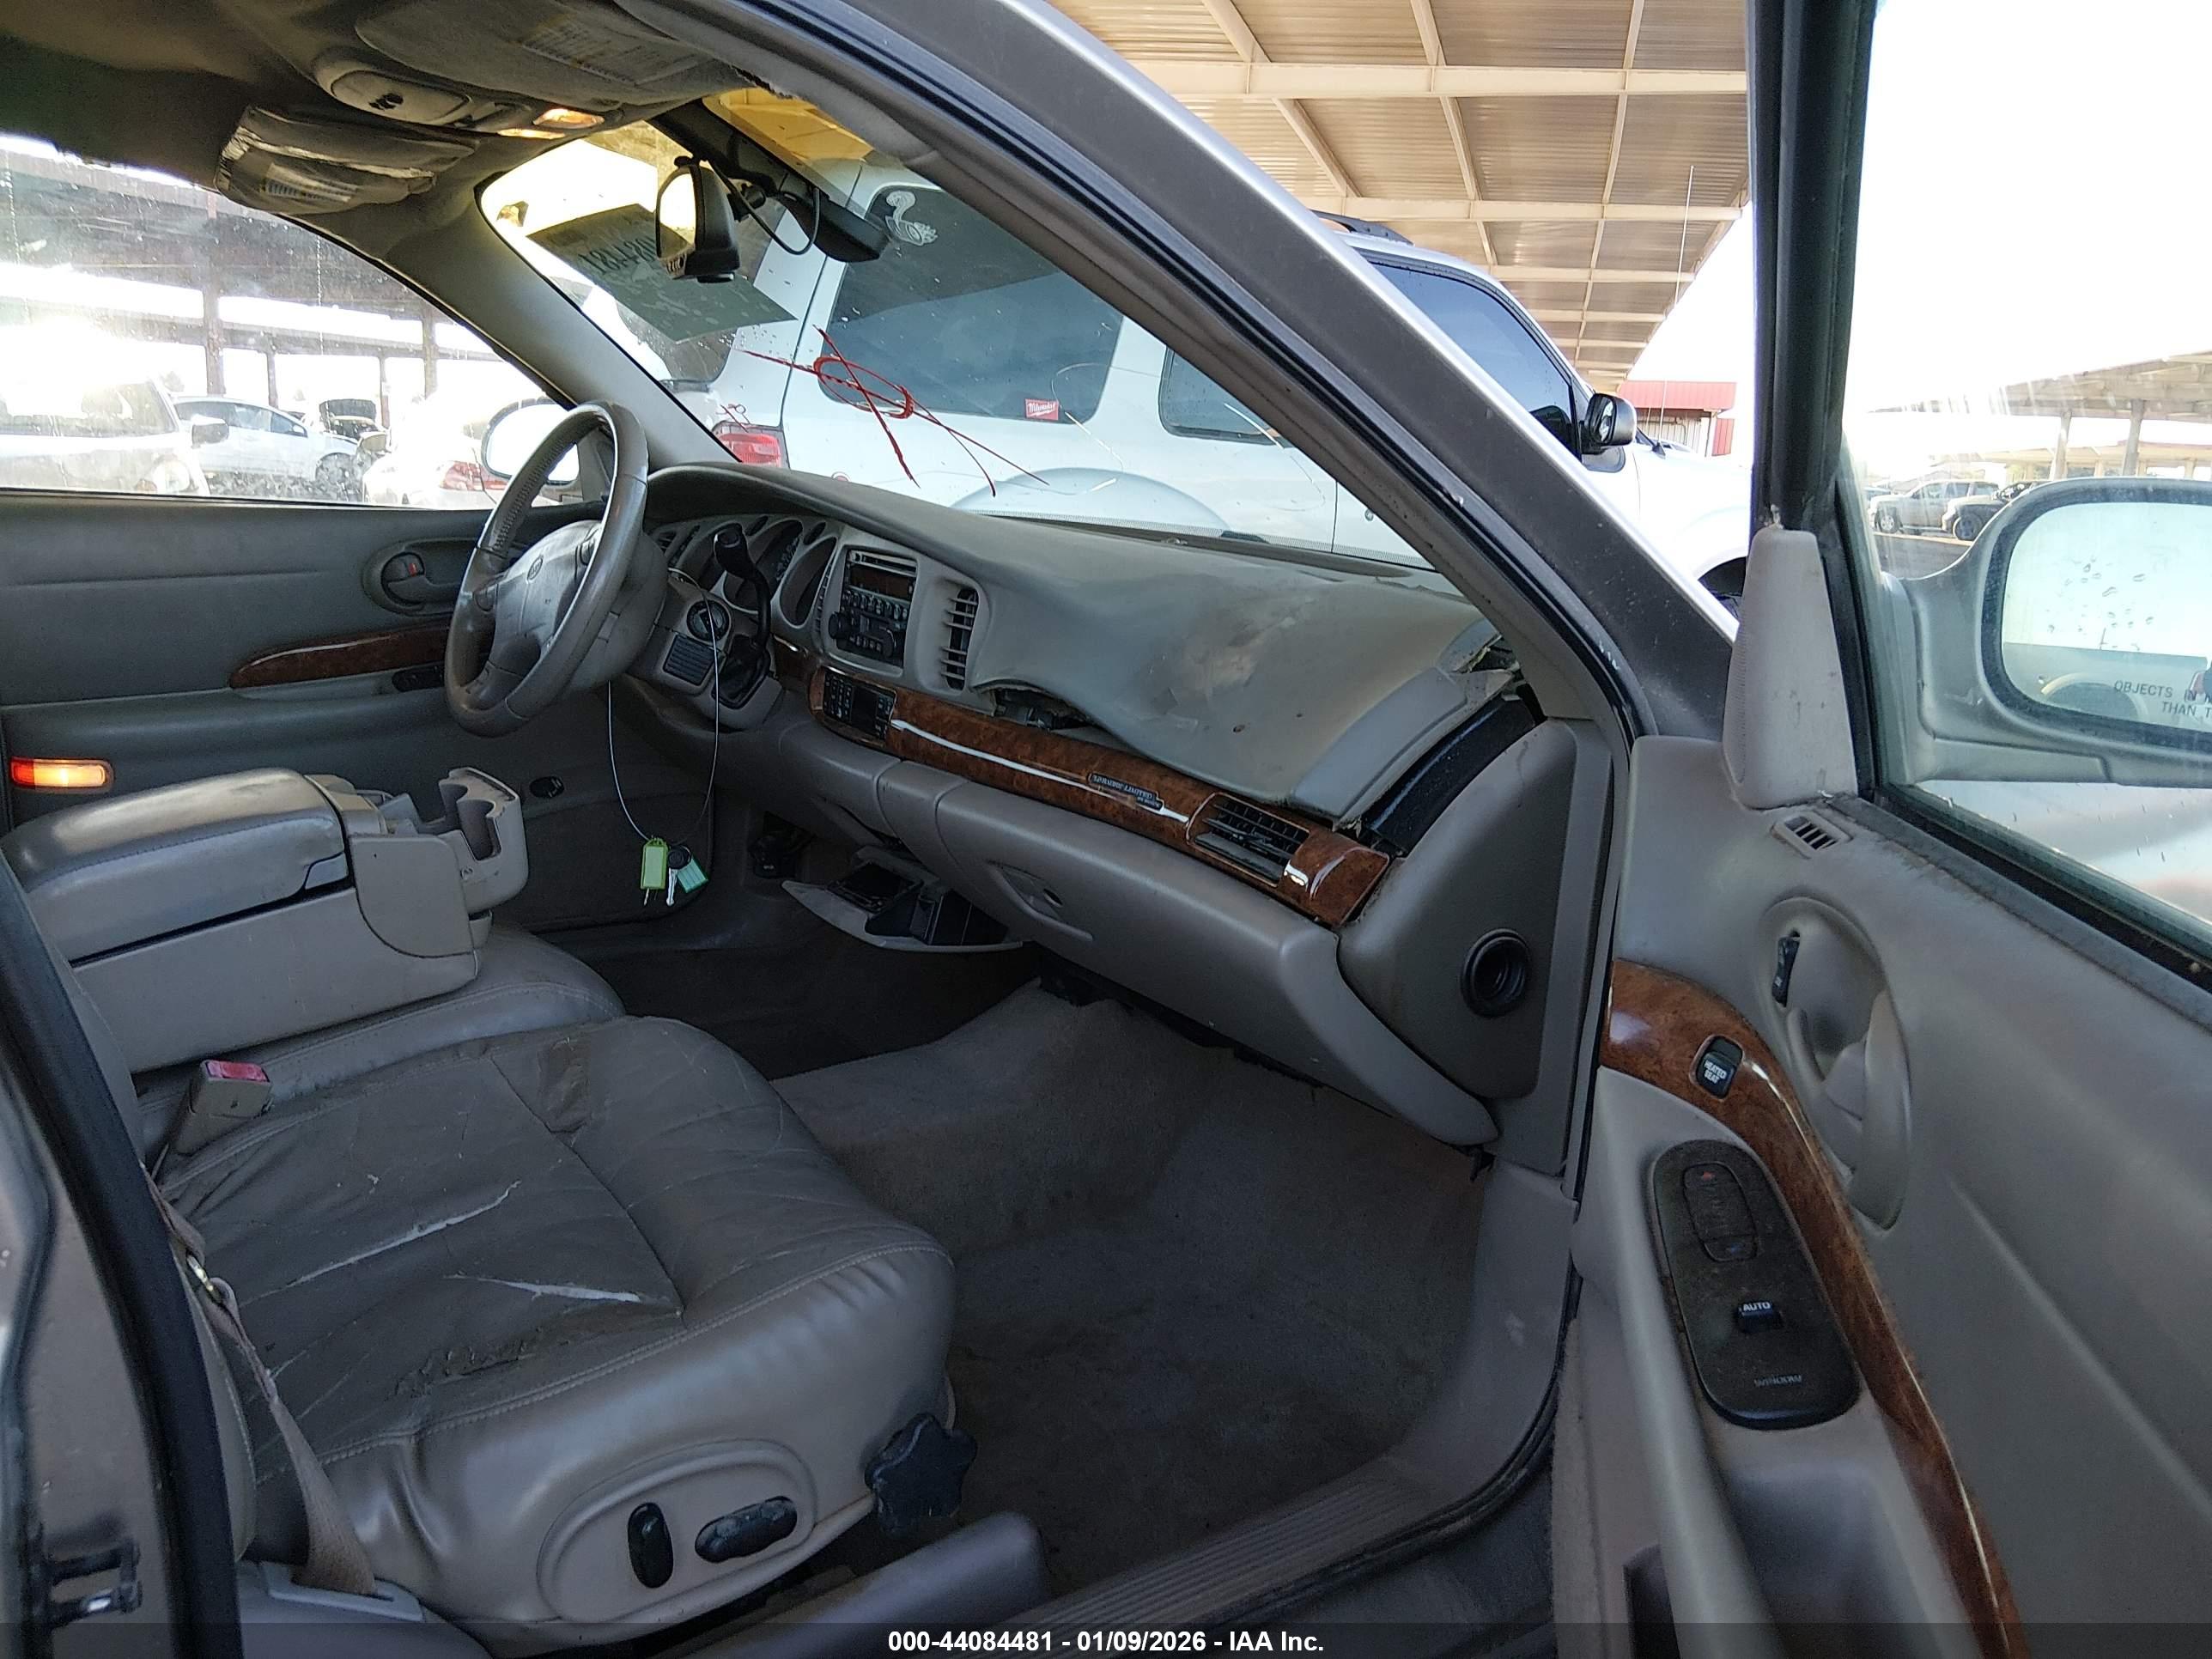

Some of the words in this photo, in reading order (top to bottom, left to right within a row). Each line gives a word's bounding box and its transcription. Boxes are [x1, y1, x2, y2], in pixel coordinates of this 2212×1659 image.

[2114, 680, 2174, 698] OBJECTS
[2184, 690, 2198, 702] IN
[2162, 701, 2197, 716] THAN
[1705, 1060, 1727, 1079] HEATED
[1705, 1069, 1720, 1084] SEAT
[1743, 1302, 1771, 1311] AUTO
[1753, 1375, 1802, 1387] WINDOW
